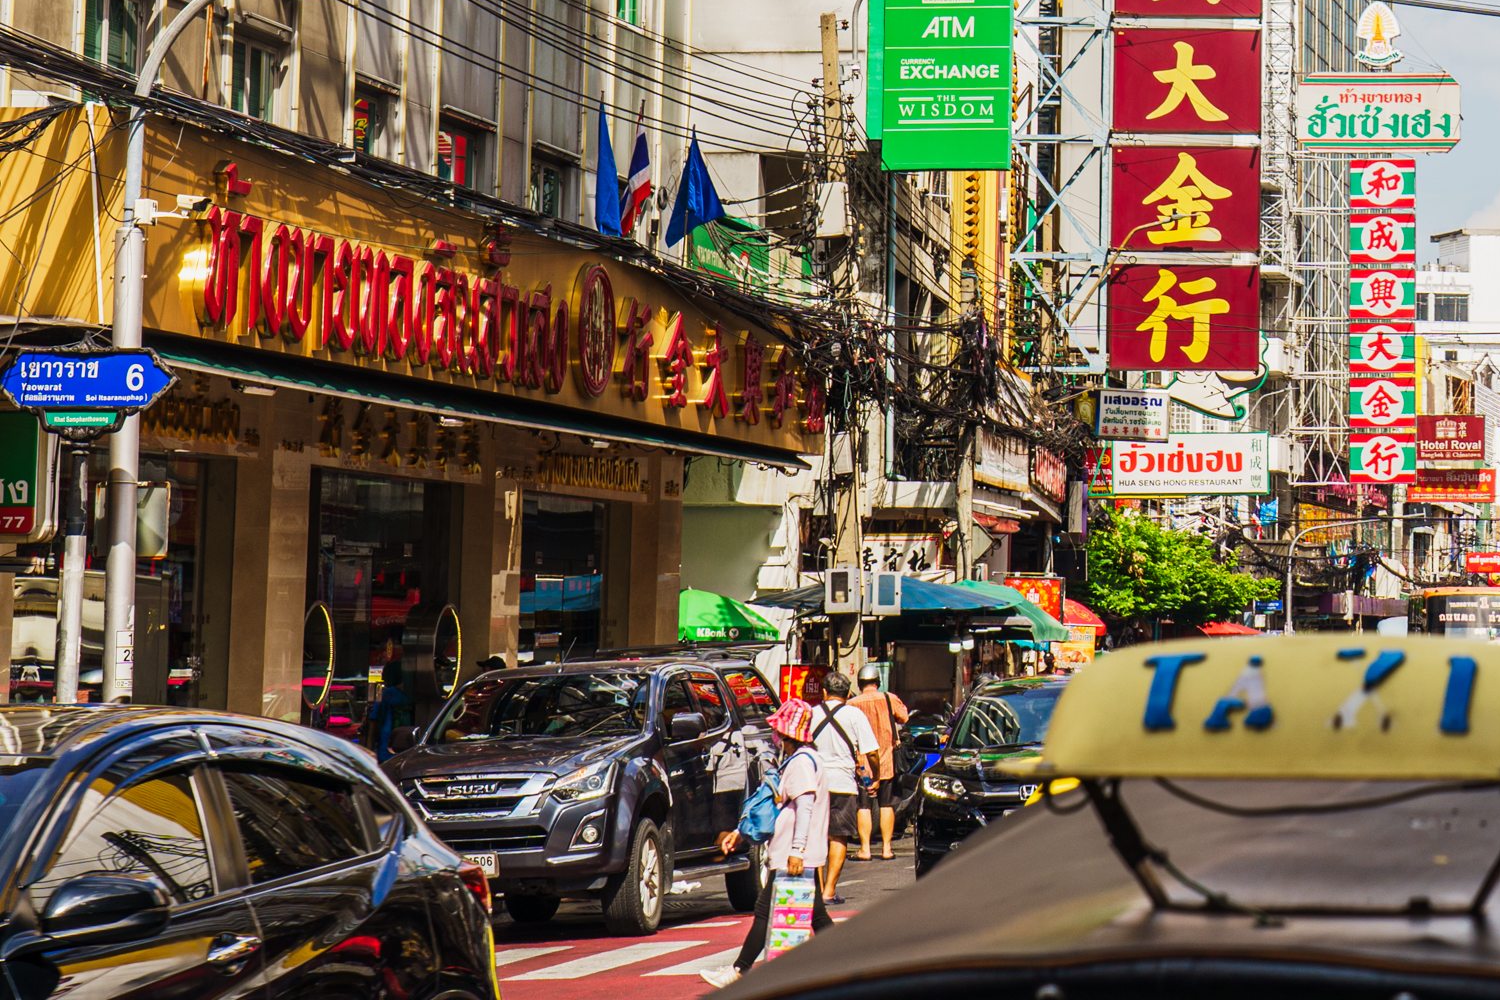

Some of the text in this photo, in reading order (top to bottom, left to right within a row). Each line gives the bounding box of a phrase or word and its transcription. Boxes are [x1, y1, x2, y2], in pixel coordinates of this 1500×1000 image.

[922, 16, 975, 38] ATM
[900, 64, 999, 79] EXCHANGE
[937, 94, 956, 102] THE
[1339, 88, 1422, 104] ห้างขายทอง
[899, 103, 994, 117] WISDOM
[1365, 167, 1400, 476] 和成興大金行
[20, 361, 144, 392] เยาวราช 6
[21, 382, 62, 392] Yaowarat
[85, 394, 97, 402] Soi
[1104, 395, 1163, 409] แสงอรุณ
[1420, 440, 1482, 451] Hotel Royal
[1119, 478, 1243, 487] HUA SENG HONG RESTAURANT
[0, 516, 25, 528] 77
[696, 627, 726, 637] KBank
[1141, 647, 1479, 733] TAXI
[447, 784, 496, 795] ISUZU
[469, 856, 493, 867] 506
